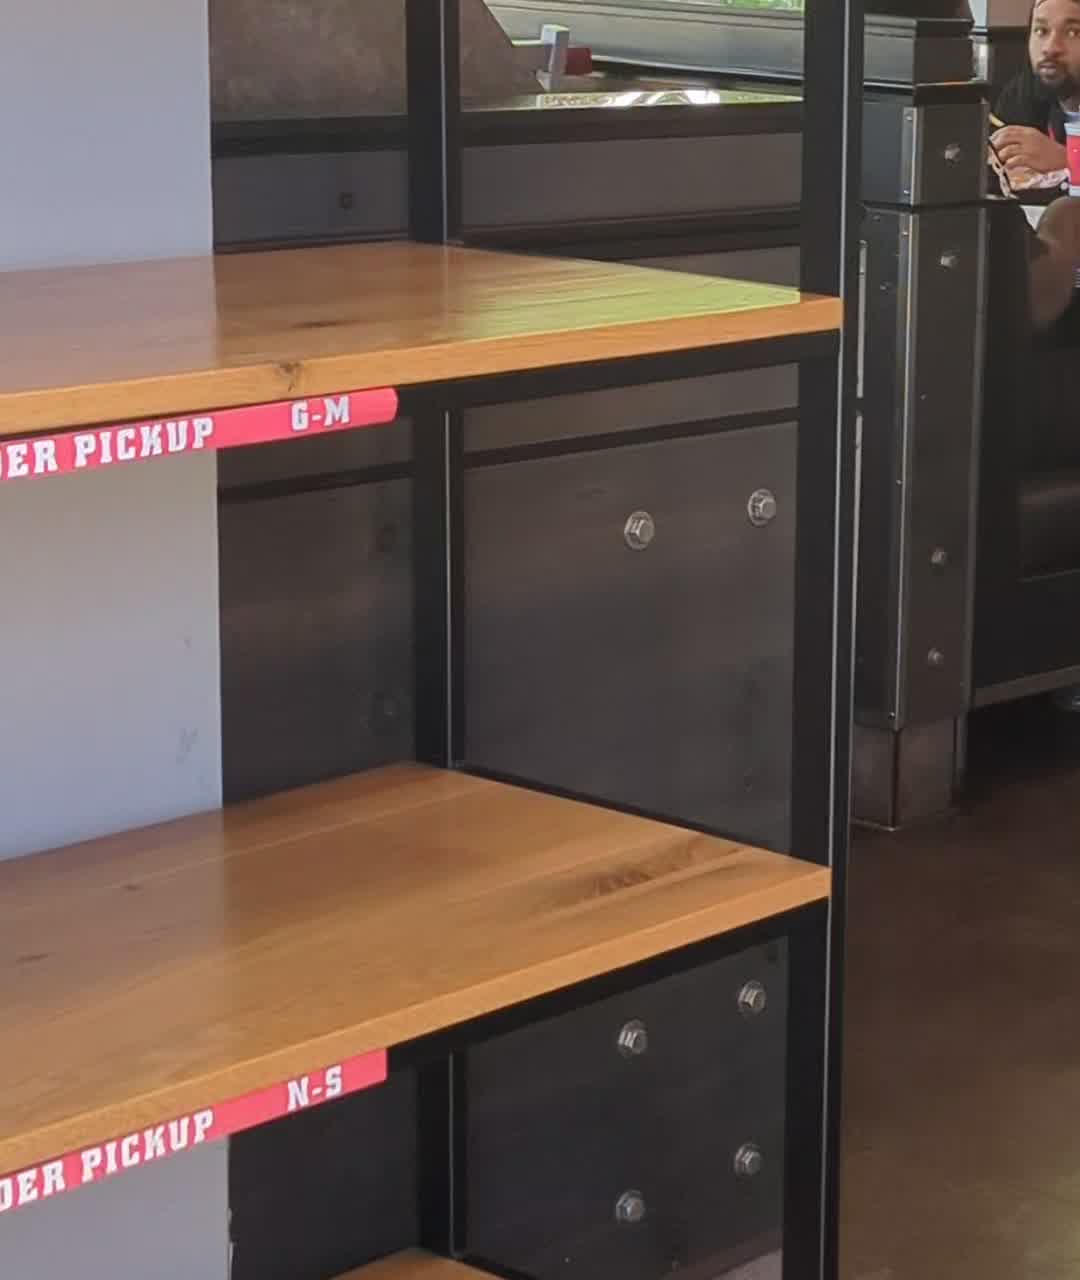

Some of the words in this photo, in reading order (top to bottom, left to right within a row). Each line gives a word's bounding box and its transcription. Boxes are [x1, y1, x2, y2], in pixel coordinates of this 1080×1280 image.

[0, 439, 58, 480] ER
[74, 416, 214, 469] PICKUP
[291, 394, 350, 431] G-M
[80, 1108, 214, 1184] PICKUP
[286, 1064, 343, 1111] N-S
